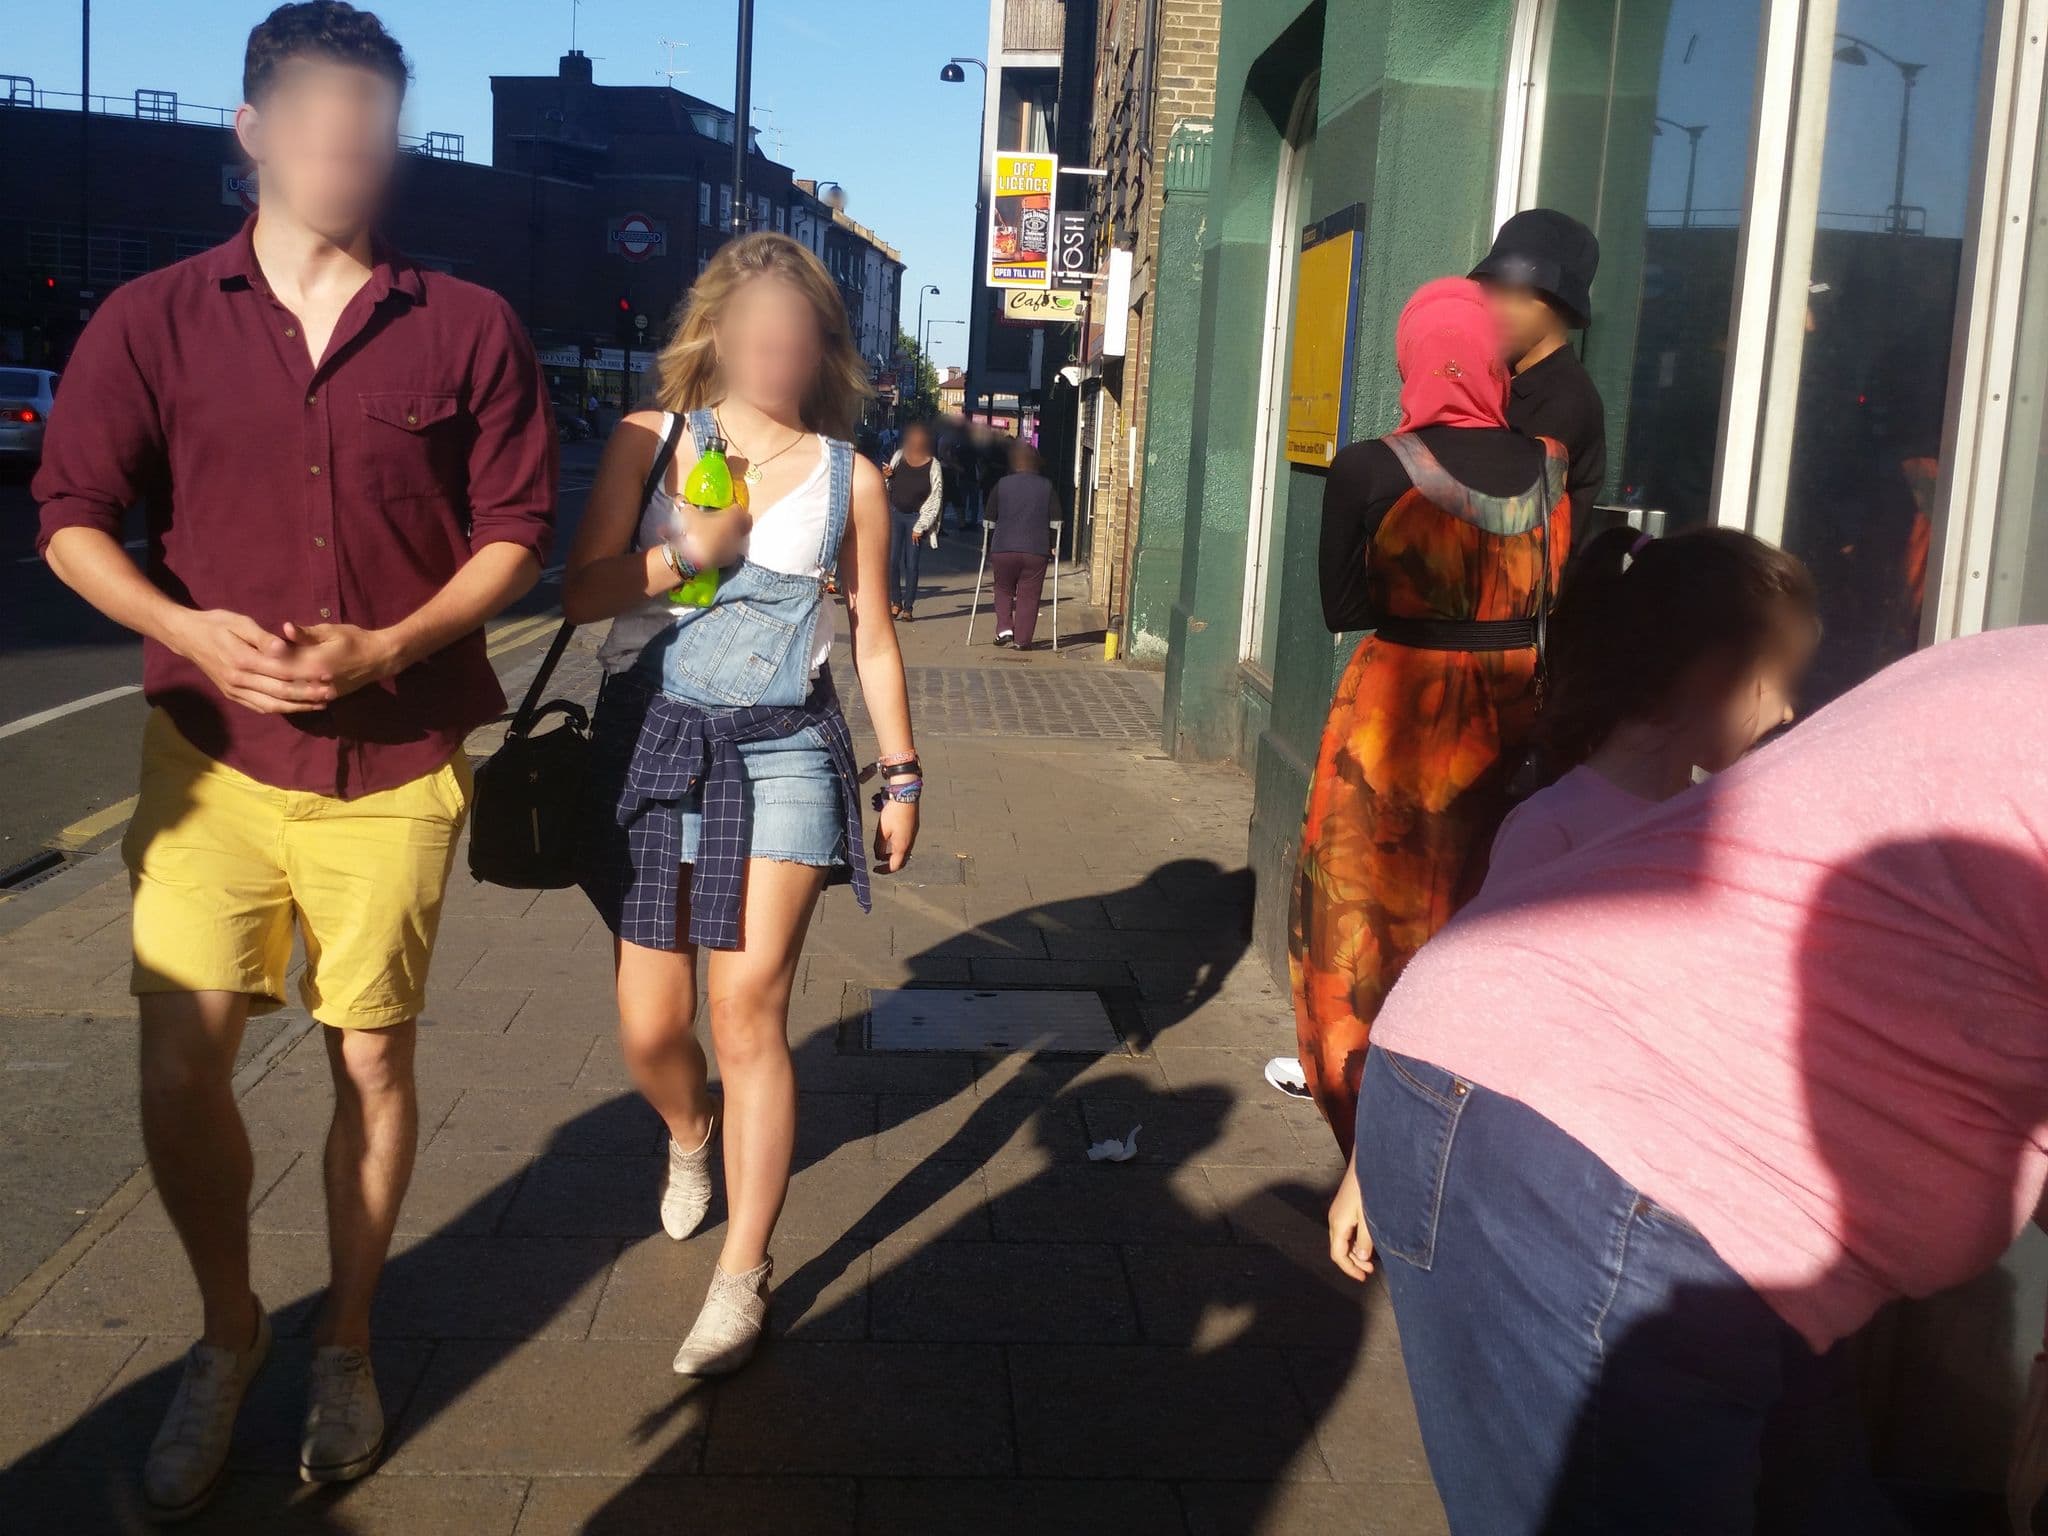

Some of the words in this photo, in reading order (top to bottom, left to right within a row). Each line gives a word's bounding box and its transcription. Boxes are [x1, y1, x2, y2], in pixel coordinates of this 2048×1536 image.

[1014, 162, 1035, 176] OFF
[999, 176, 1049, 192] LICENCE
[995, 268, 1011, 277] OPEN
[1012, 268, 1027, 278] TILL
[1028, 269, 1045, 279] LATE
